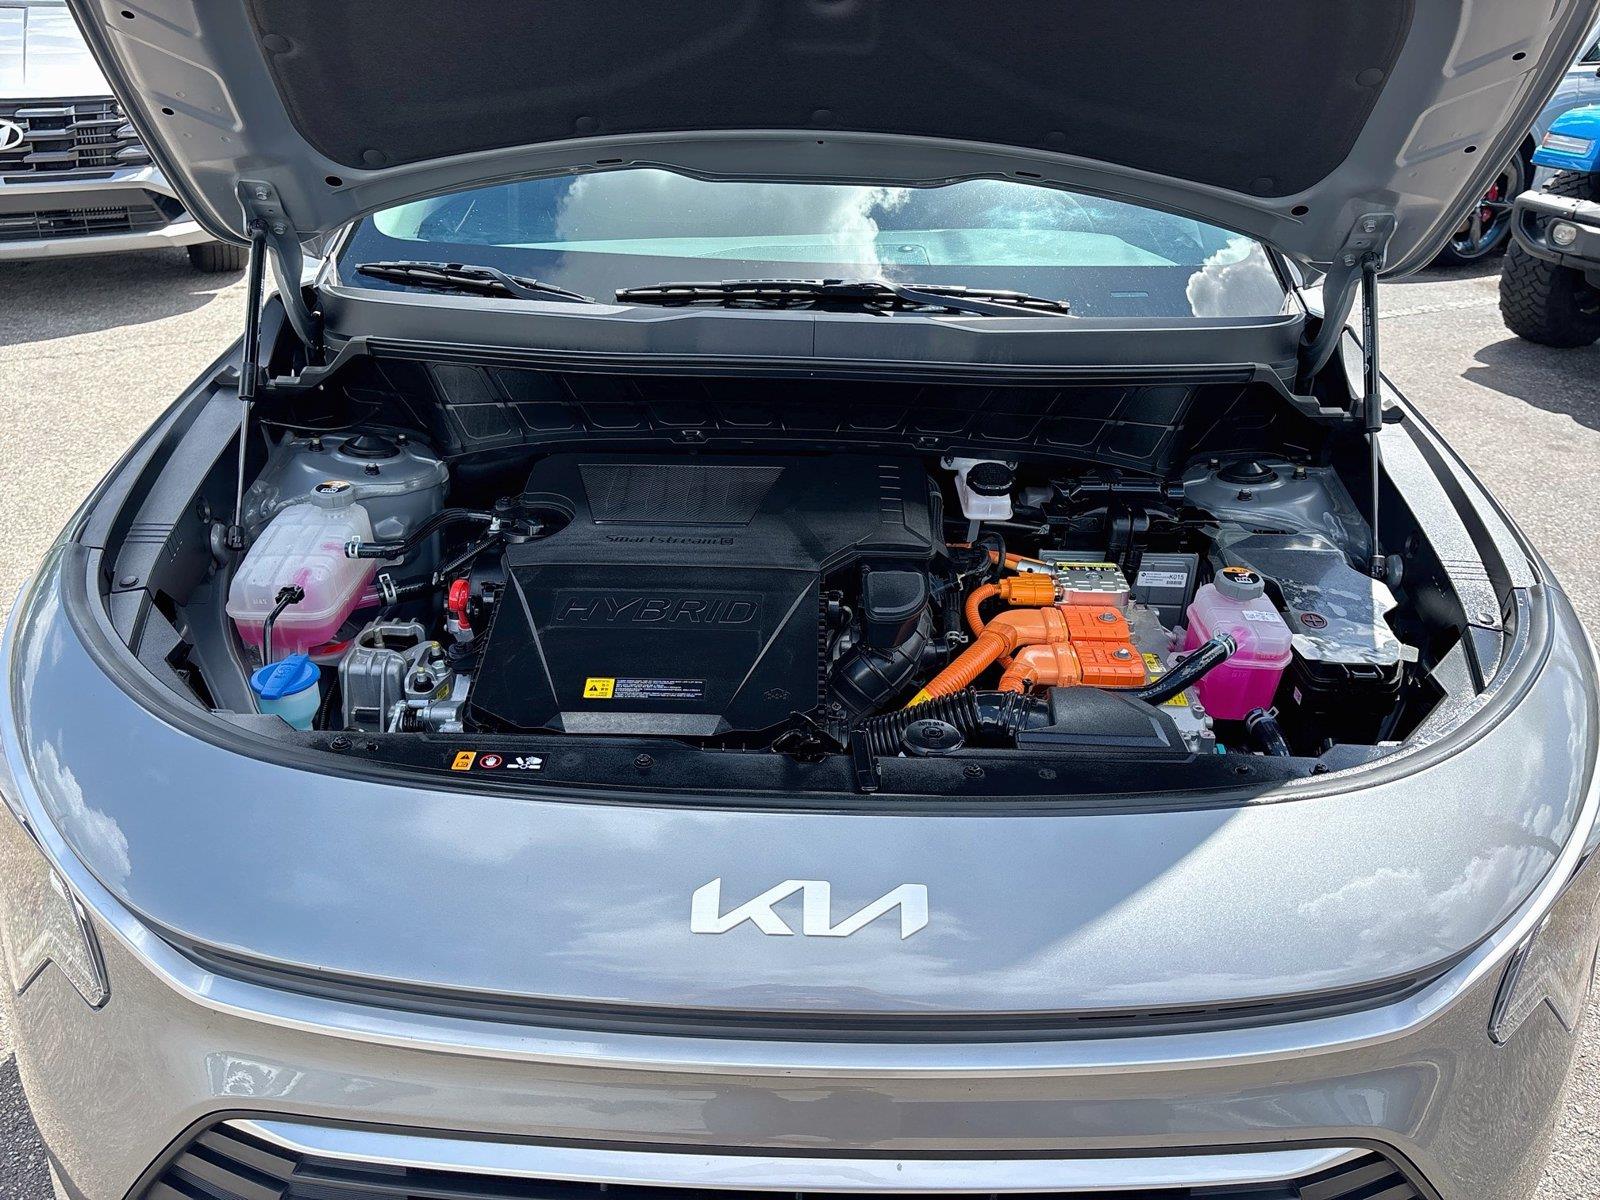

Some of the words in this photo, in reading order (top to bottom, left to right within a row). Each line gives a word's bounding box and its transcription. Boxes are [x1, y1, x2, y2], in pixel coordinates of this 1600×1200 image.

[605, 535, 718, 545] Smartstream
[555, 597, 758, 624] HYBRID
[690, 877, 928, 940] KIA
